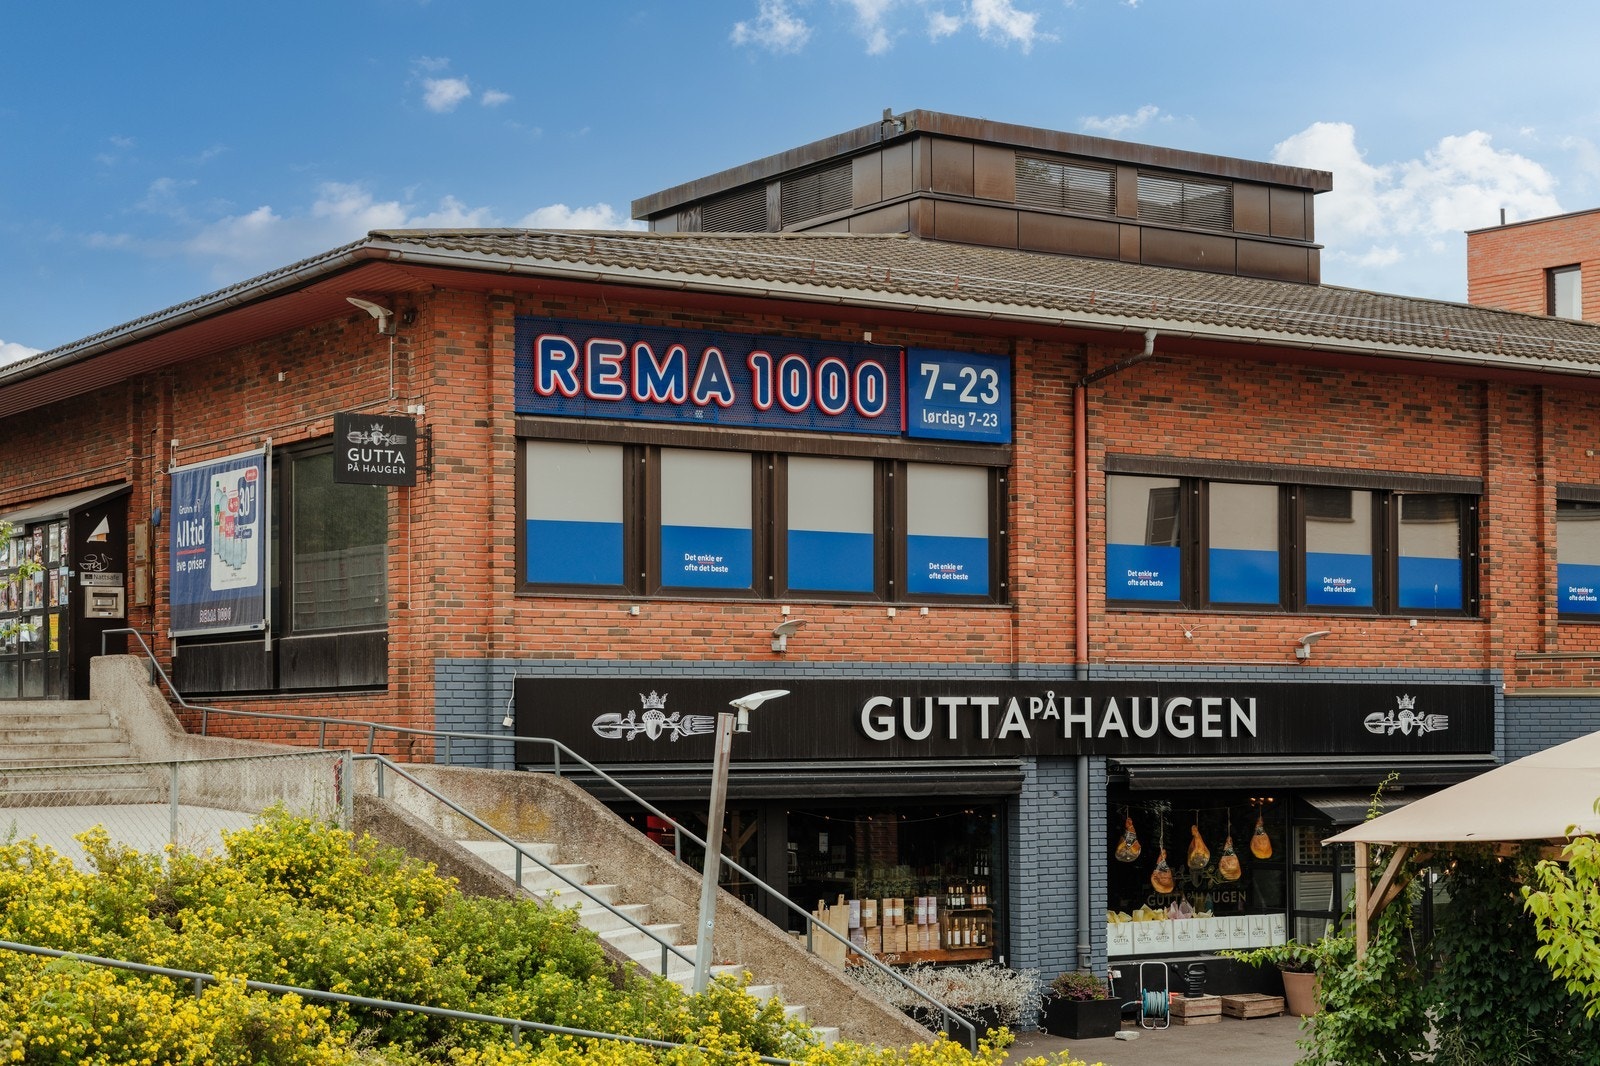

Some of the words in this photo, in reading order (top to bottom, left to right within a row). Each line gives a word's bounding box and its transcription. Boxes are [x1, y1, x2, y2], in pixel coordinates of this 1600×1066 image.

[534, 333, 735, 408] REMA
[747, 350, 888, 418] 1000
[920, 362, 999, 405] 7-23
[923, 409, 965, 428] lørdag
[968, 412, 998, 427] 7-23
[347, 447, 406, 464] GUTTA
[347, 462, 360, 472] PÅ
[362, 464, 406, 474] HAUGEN
[176, 518, 205, 548] Alltid
[684, 553, 697, 561] Det
[697, 554, 715, 562] enkle
[710, 565, 729, 573] beste
[929, 562, 940, 570] Det
[929, 572, 941, 580] ofte
[861, 695, 1031, 741] GUTTA
[1029, 690, 1060, 720] PÅ
[1063, 696, 1257, 740] HAUGEN
[1196, 890, 1247, 904] HAUGEN
